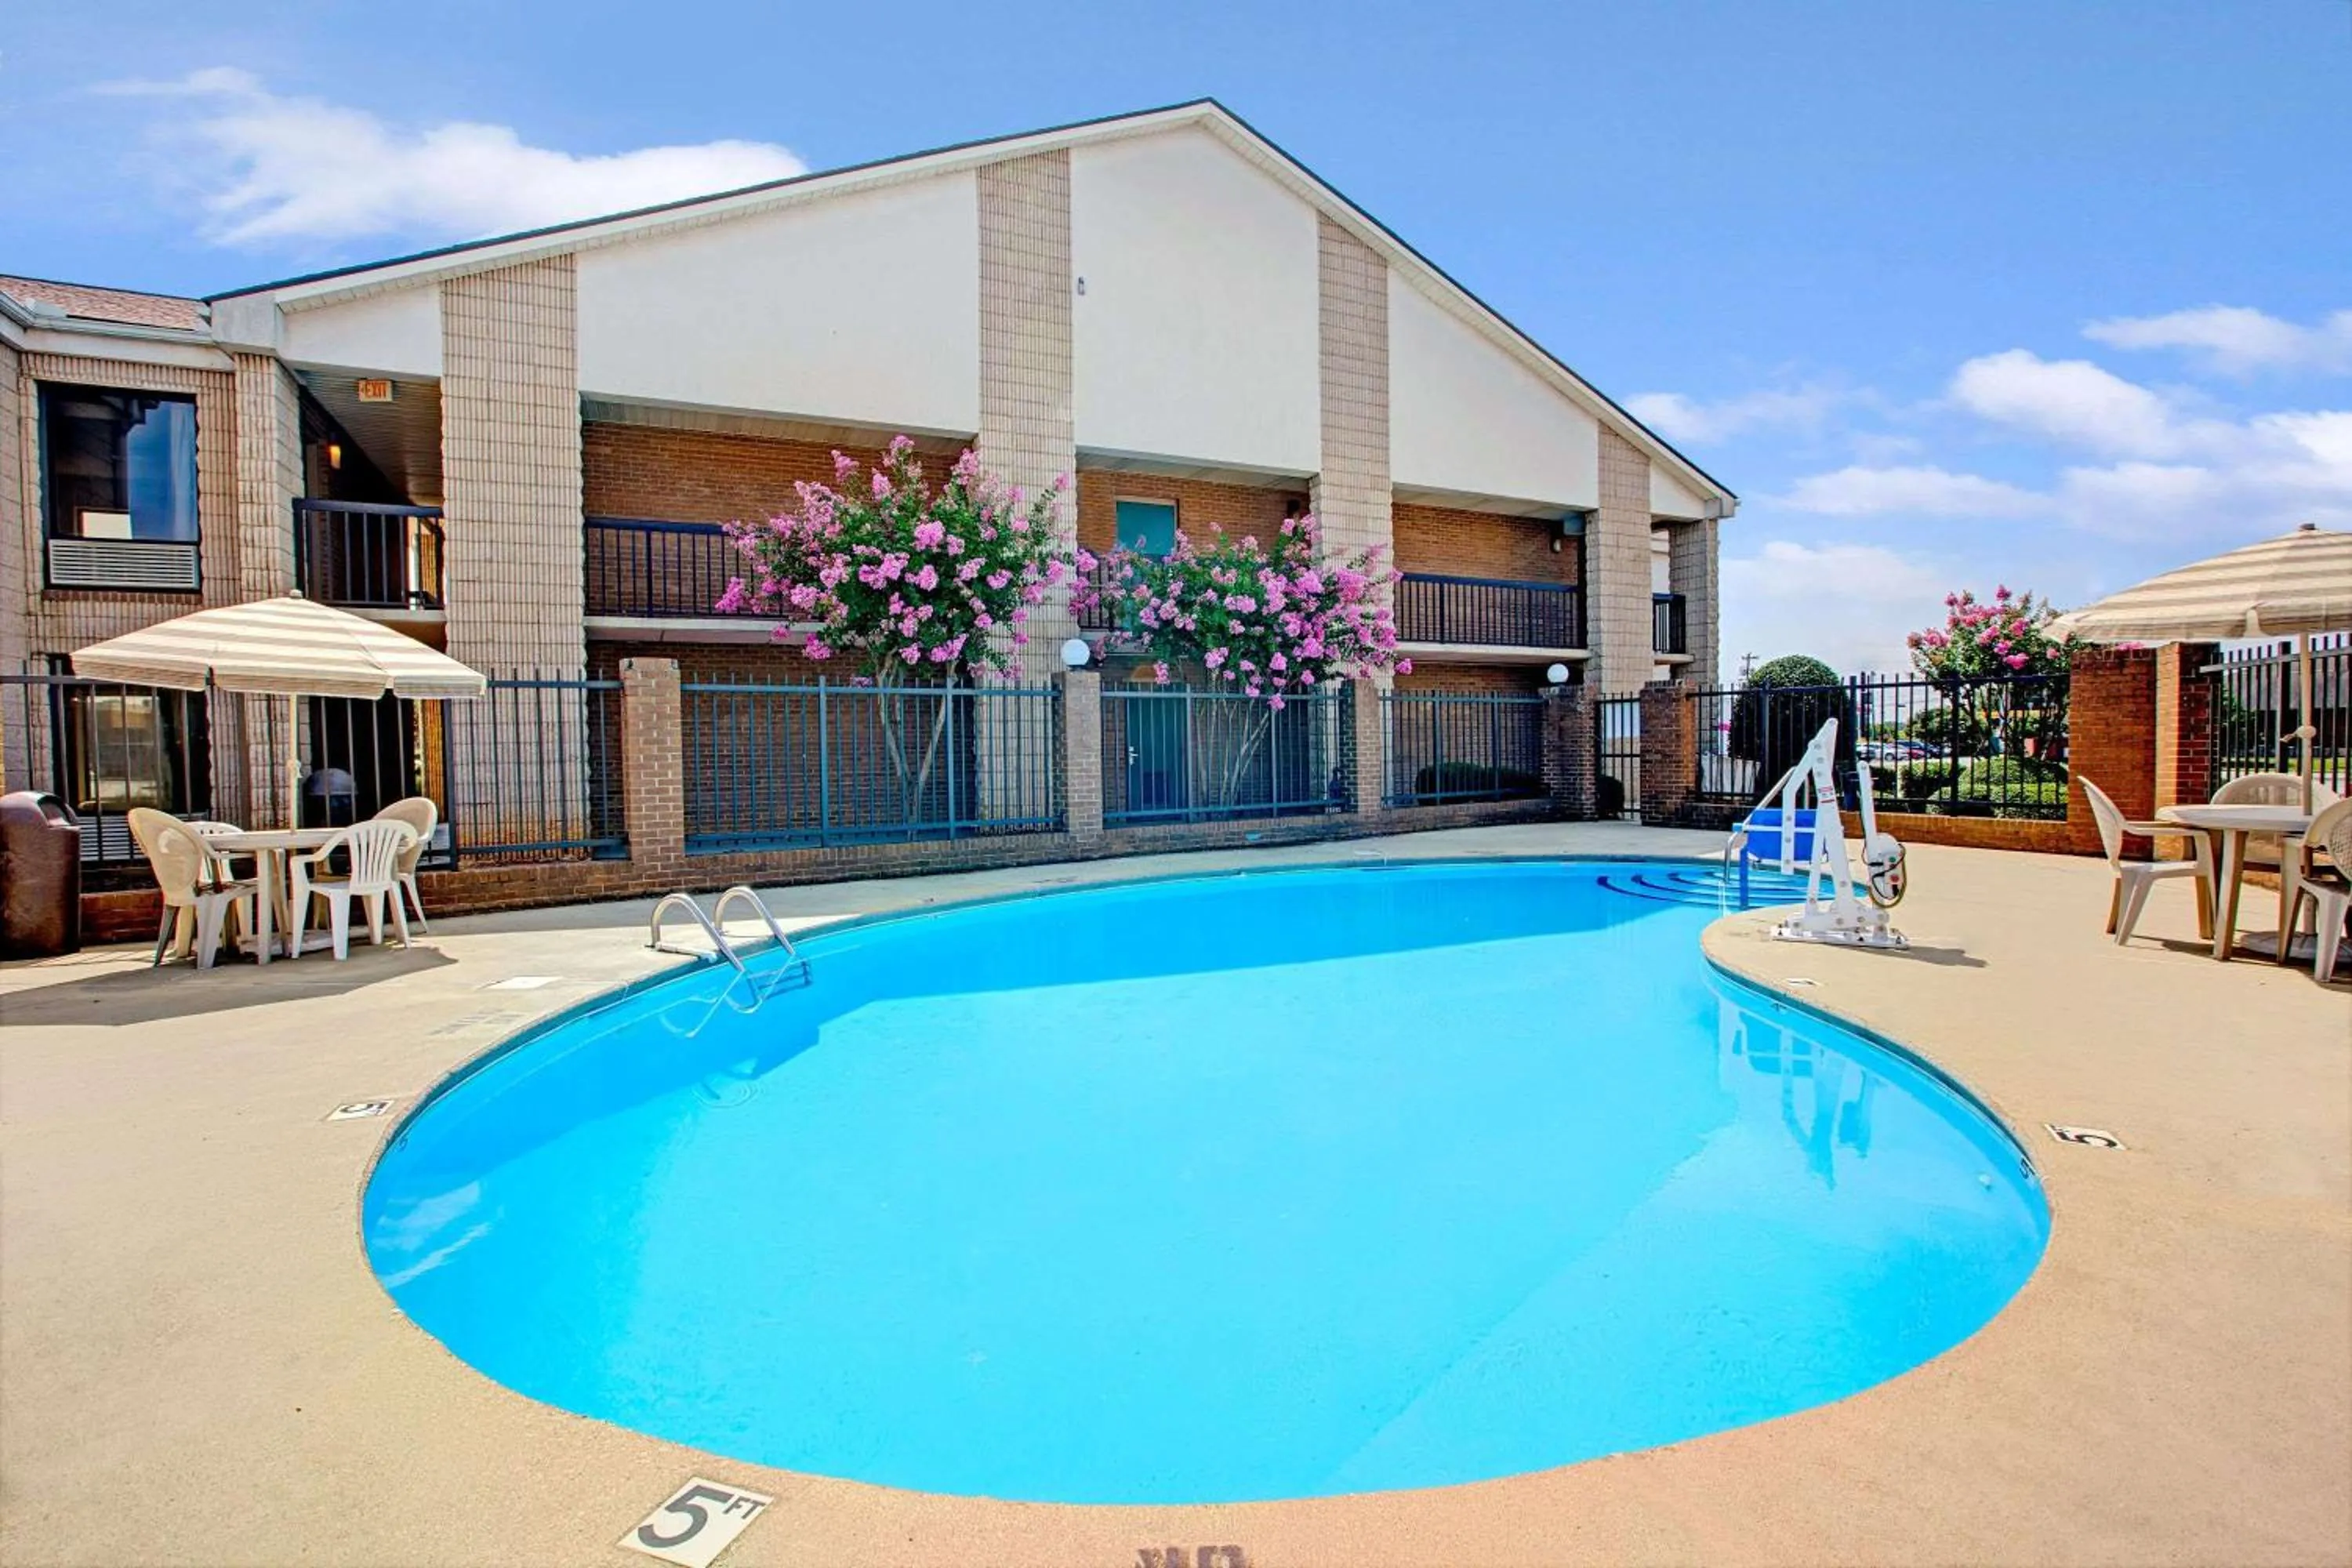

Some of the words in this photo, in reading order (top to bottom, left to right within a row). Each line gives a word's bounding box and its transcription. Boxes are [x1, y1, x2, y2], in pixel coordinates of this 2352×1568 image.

[365, 381, 387, 398] EXIT
[2056, 1131, 2118, 1148] 5
[637, 1485, 735, 1548] 5
[722, 1495, 766, 1519] FT
